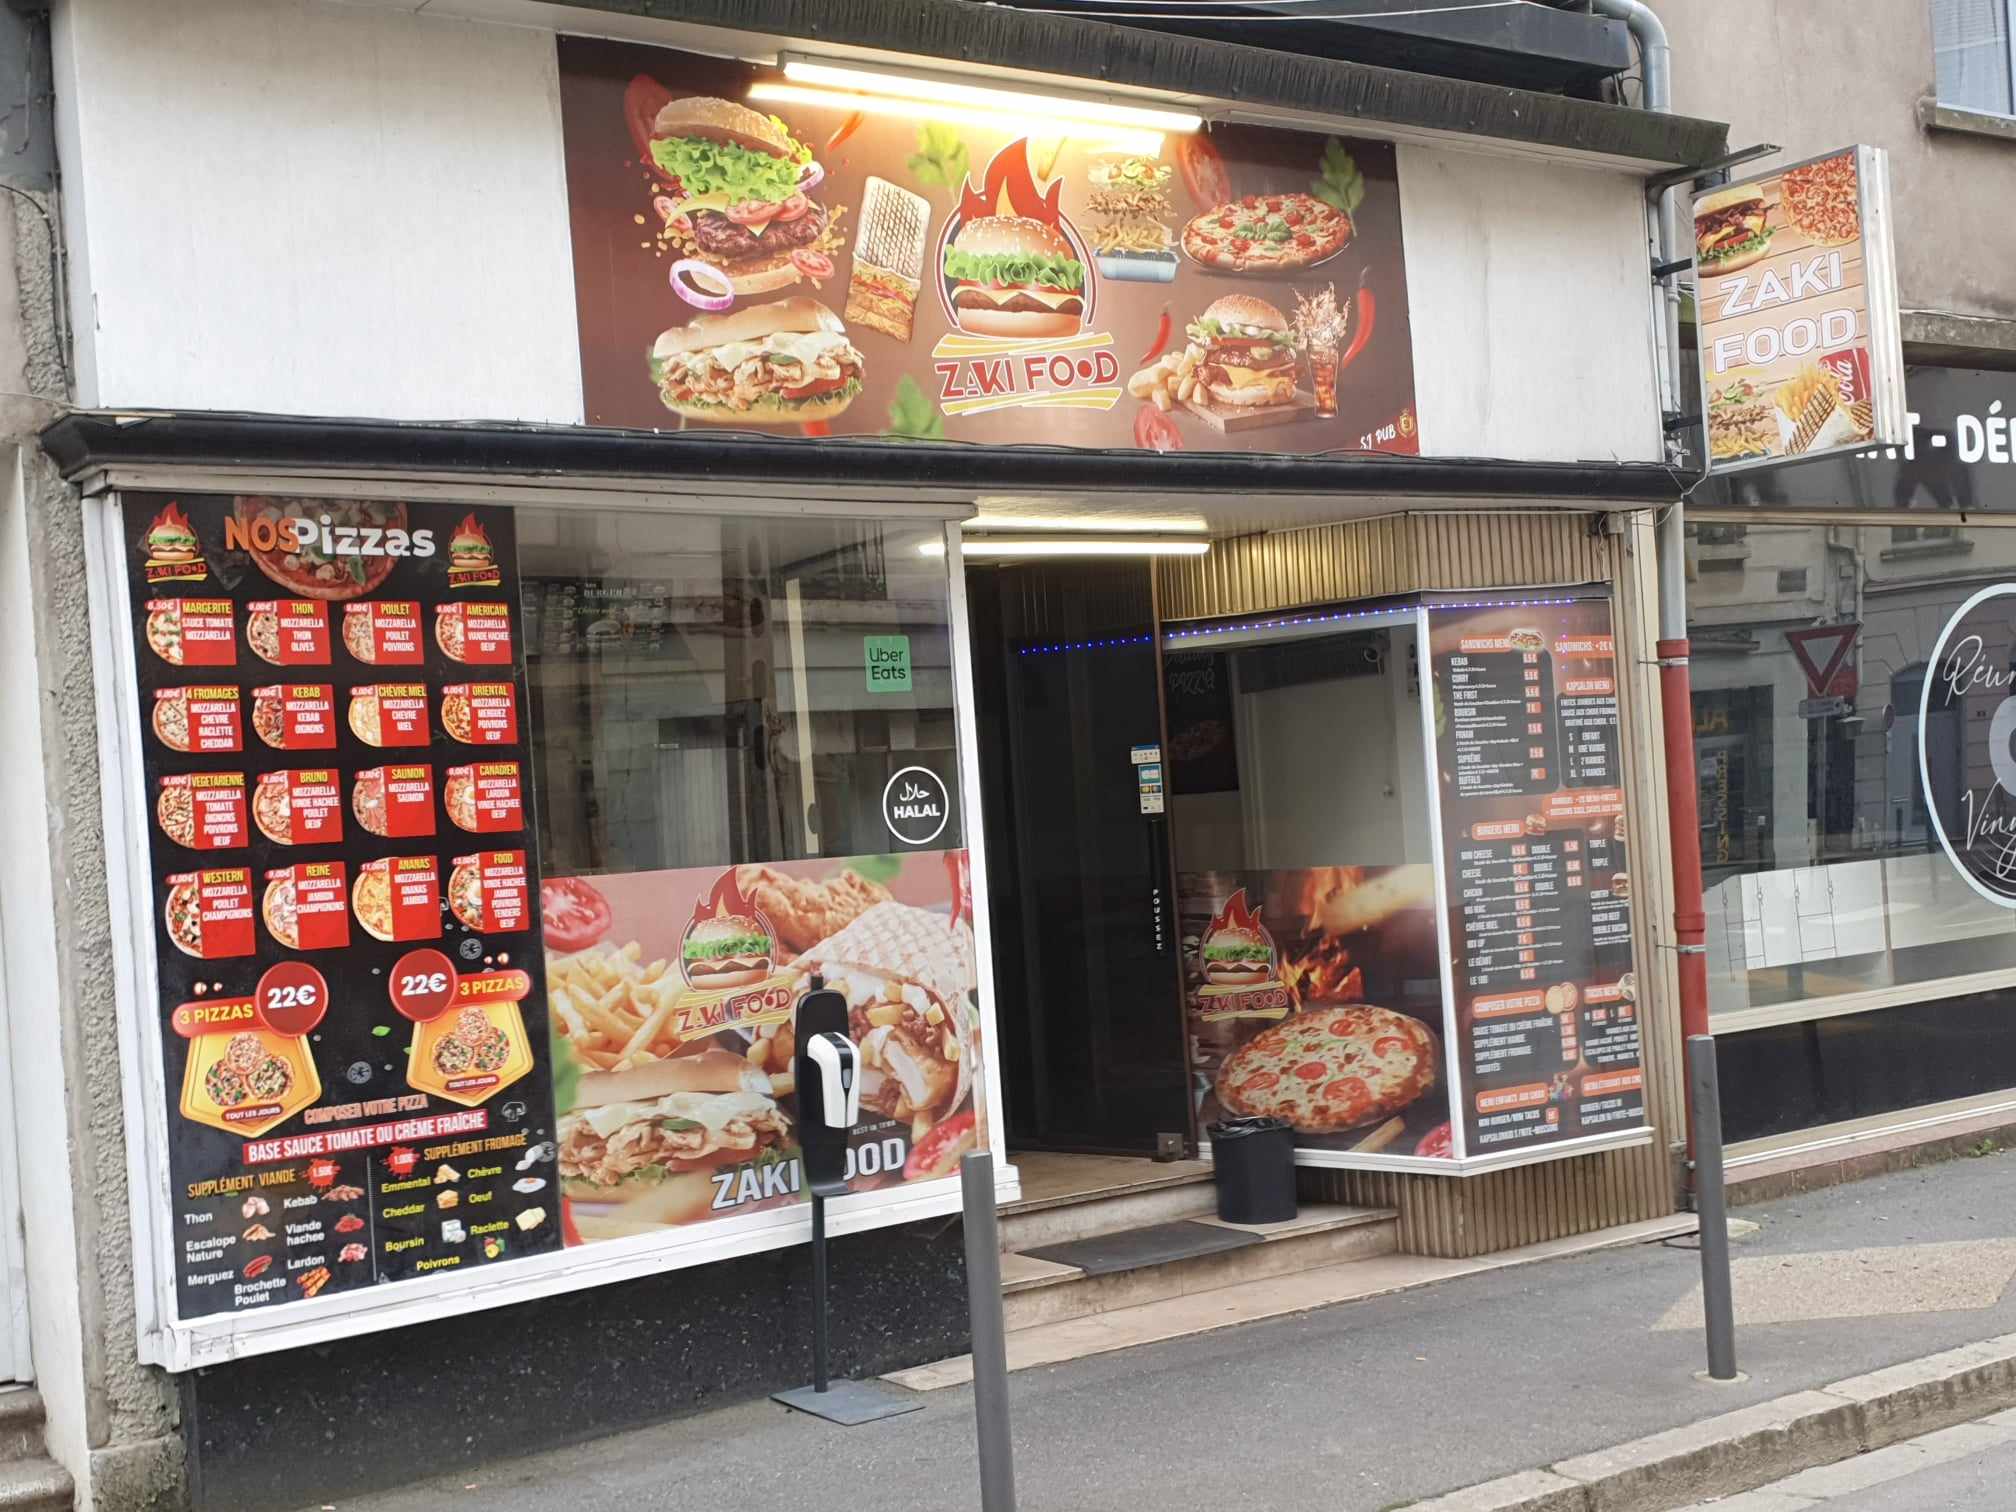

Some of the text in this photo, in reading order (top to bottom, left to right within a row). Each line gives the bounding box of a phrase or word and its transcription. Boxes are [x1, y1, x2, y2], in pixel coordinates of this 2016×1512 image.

[1720, 251, 1842, 317] ZAKI
[1713, 308, 1858, 374] FOOD
[1023, 350, 1119, 391] FOOD
[1957, 399, 2016, 463] DÉ
[225, 514, 436, 557] NOS Pizzas
[182, 602, 232, 614] MARGERITE
[291, 603, 314, 615] THON
[380, 603, 410, 615] POULET
[466, 604, 508, 616] AMERICAIN
[280, 617, 324, 628] MOZZARELLA
[375, 618, 416, 629] MOZZARELLA
[467, 619, 506, 629] MOZZARELLA
[185, 630, 231, 641] MOZZARELLA
[385, 630, 409, 641] POULET
[291, 641, 314, 652] OLIVES
[869, 647, 904, 663] Uber
[872, 665, 906, 681] Eats
[186, 687, 239, 700] 4 FROMAGES
[292, 687, 321, 699] KEBAB
[409, 685, 426, 697] MIEL
[472, 685, 509, 696] ORIENTAL
[190, 702, 236, 714] MOZZARELLA
[286, 701, 329, 711] MOZZARELLA
[383, 699, 424, 709] MOZZARELLA
[471, 698, 511, 708] MOZZARELLA
[299, 771, 328, 783] BRUNO
[391, 767, 425, 780] SAUMON
[192, 775, 245, 787] VEGETARIENNE
[388, 782, 430, 793] MOZZARELLA
[478, 778, 517, 788] MOZZARELLA
[195, 790, 241, 801] MOZZARELLA
[292, 786, 336, 797] MOZZARELLA
[893, 803, 941, 820] HALAL
[399, 858, 431, 870] ANANAS
[494, 853, 513, 864] FOOD
[203, 869, 244, 883] WESTERN
[306, 864, 331, 877] REINE
[394, 872, 436, 883] MOZZARELLA
[202, 885, 248, 897] MOZZARELLA
[297, 878, 342, 890] MOZZARELLA
[1152, 888, 1163, 950] POUSSEZ
[401, 972, 448, 997] 22€
[460, 976, 525, 996] 3 PIZZAS
[267, 984, 317, 1009] 22€
[731, 987, 792, 1019] FOOD
[1240, 988, 1287, 1010] FOOD
[180, 1003, 254, 1025] 3 PIZZAS
[363, 1097, 397, 1116] VOTRE
[226, 1107, 281, 1121] TOUT LES JOURS
[248, 1110, 487, 1163] BASE SAUCE TOMATE OU CRÈME FRAÎCHE
[423, 1133, 528, 1161] SUPPLÉMENT FROMAGE
[187, 1168, 296, 1199] SUPPLÉMENT VIANDE
[381, 1176, 431, 1194] Emmental
[711, 1159, 800, 1210] ZAKI
[283, 1194, 317, 1209] Kebab
[383, 1203, 425, 1219] Cheddar
[184, 1212, 213, 1225] Thon
[286, 1220, 322, 1234] Viande
[470, 1220, 509, 1236] Raclette
[186, 1235, 237, 1252] Escalope
[385, 1236, 425, 1253] Boursin
[186, 1248, 223, 1264] Nature
[287, 1254, 325, 1270] Lardon
[416, 1255, 461, 1272] Poivrons
[188, 1269, 235, 1287] Merguez
[234, 1277, 286, 1297] Brochette
[235, 1291, 270, 1307] Poulet
